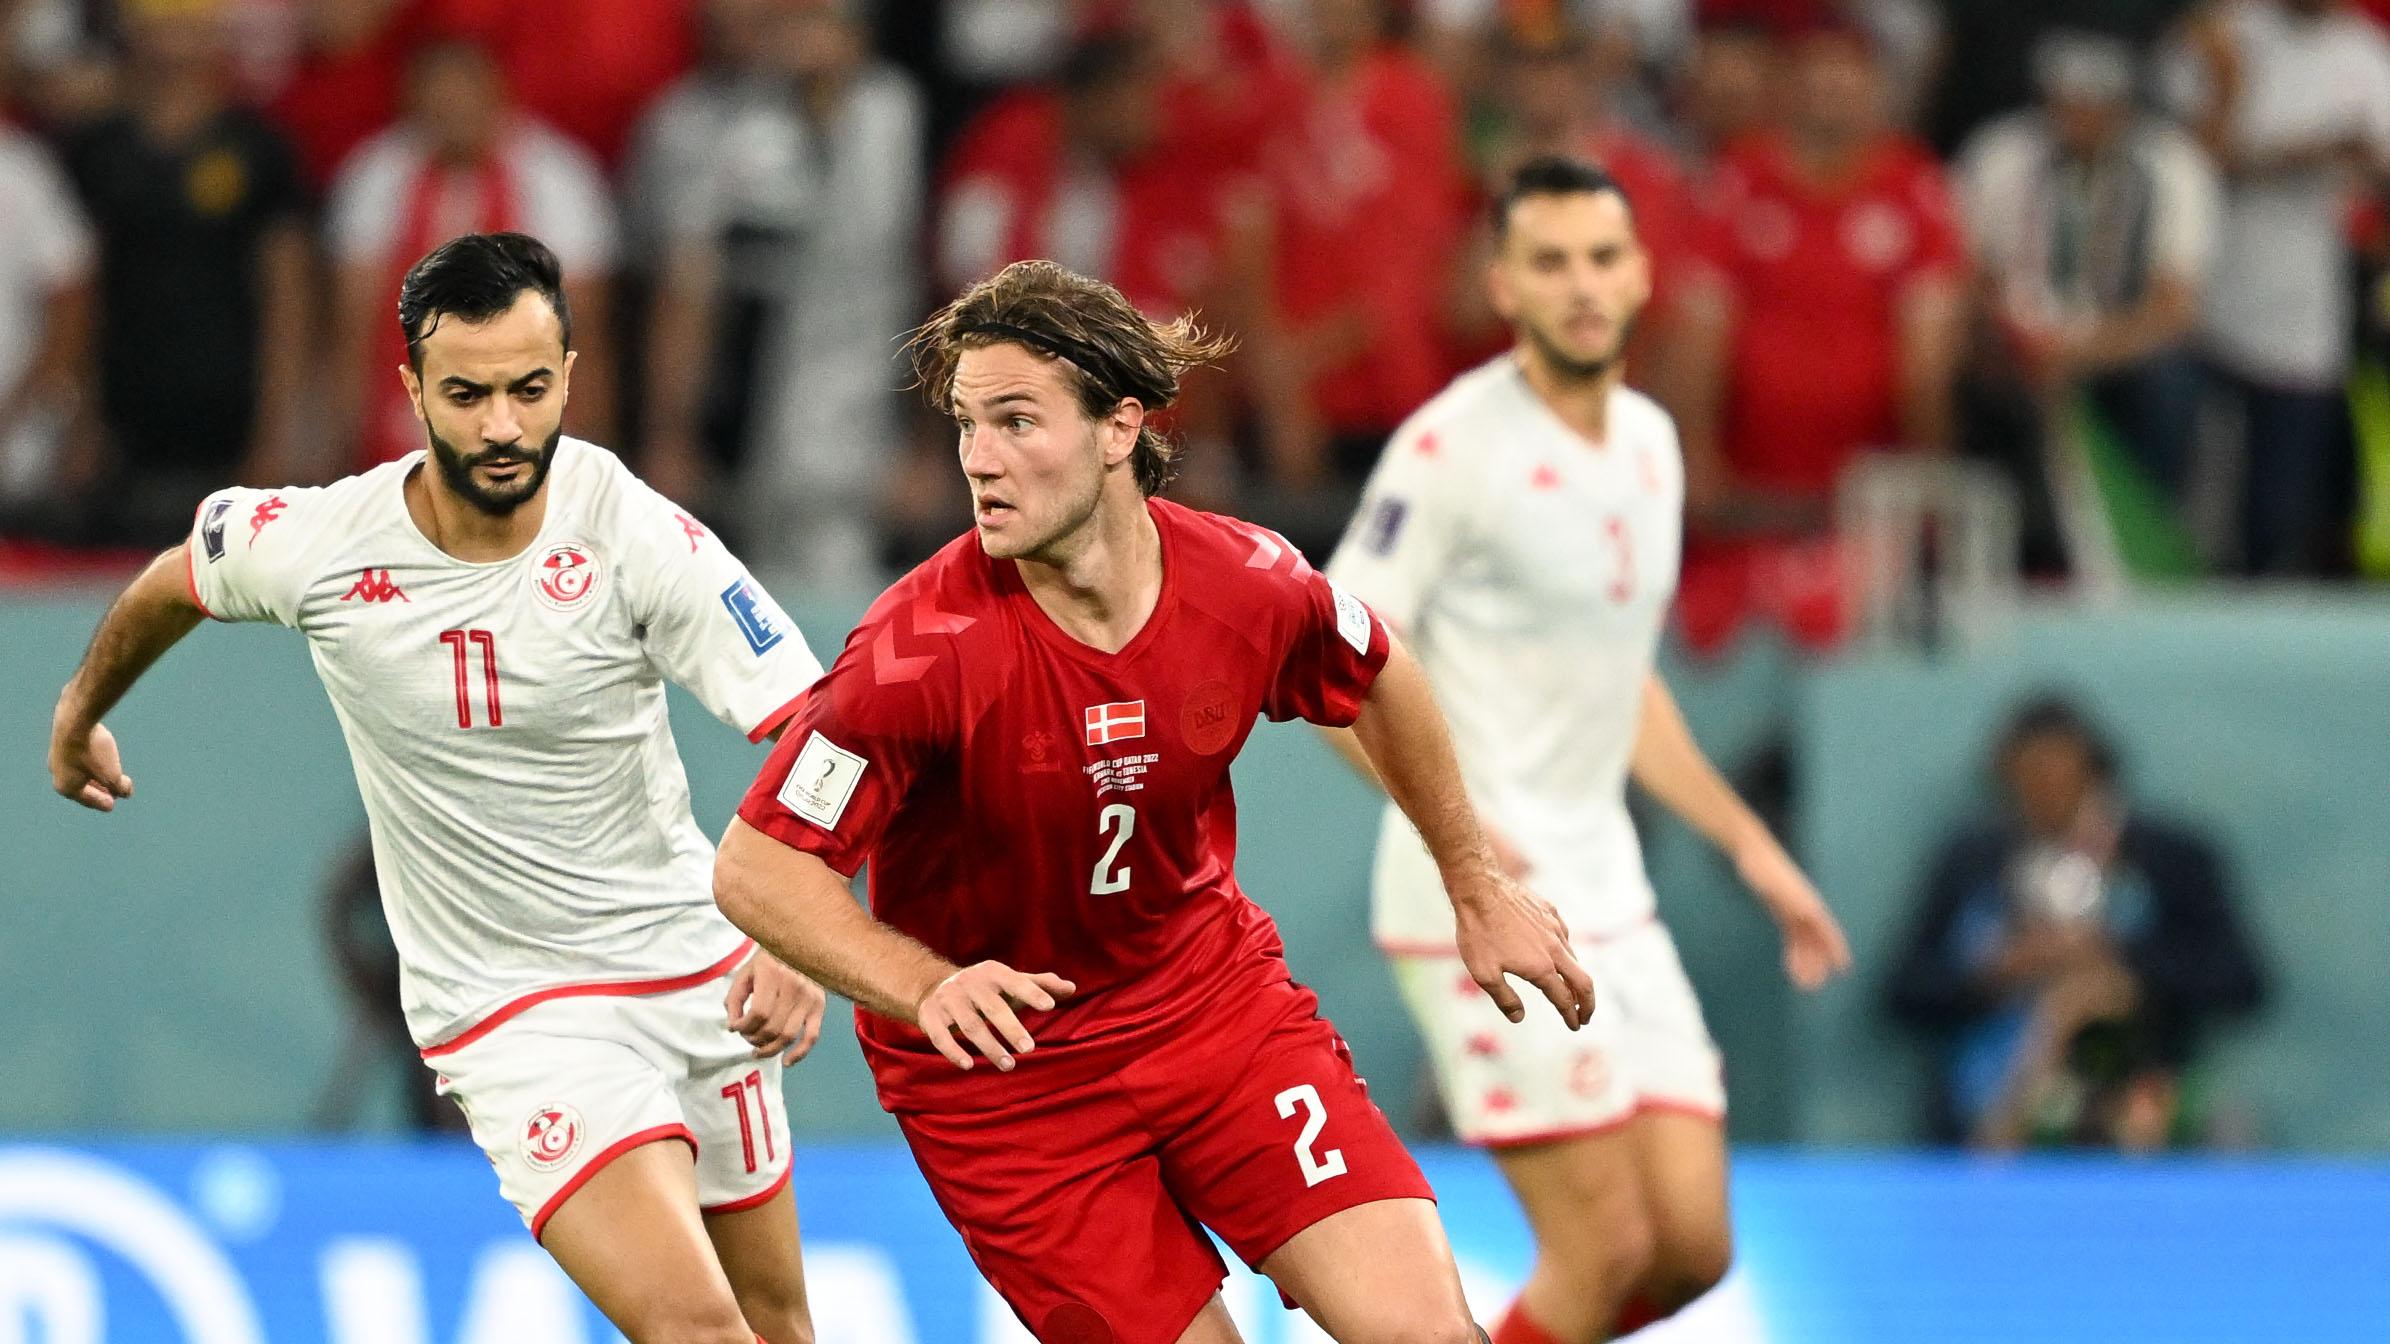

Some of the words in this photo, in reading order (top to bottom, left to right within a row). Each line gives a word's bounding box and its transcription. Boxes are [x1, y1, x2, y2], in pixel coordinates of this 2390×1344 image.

[439, 629, 503, 729] 11
[1090, 803, 1136, 895] 2
[721, 1069, 775, 1174] 11
[1274, 1083, 1348, 1188] 2
